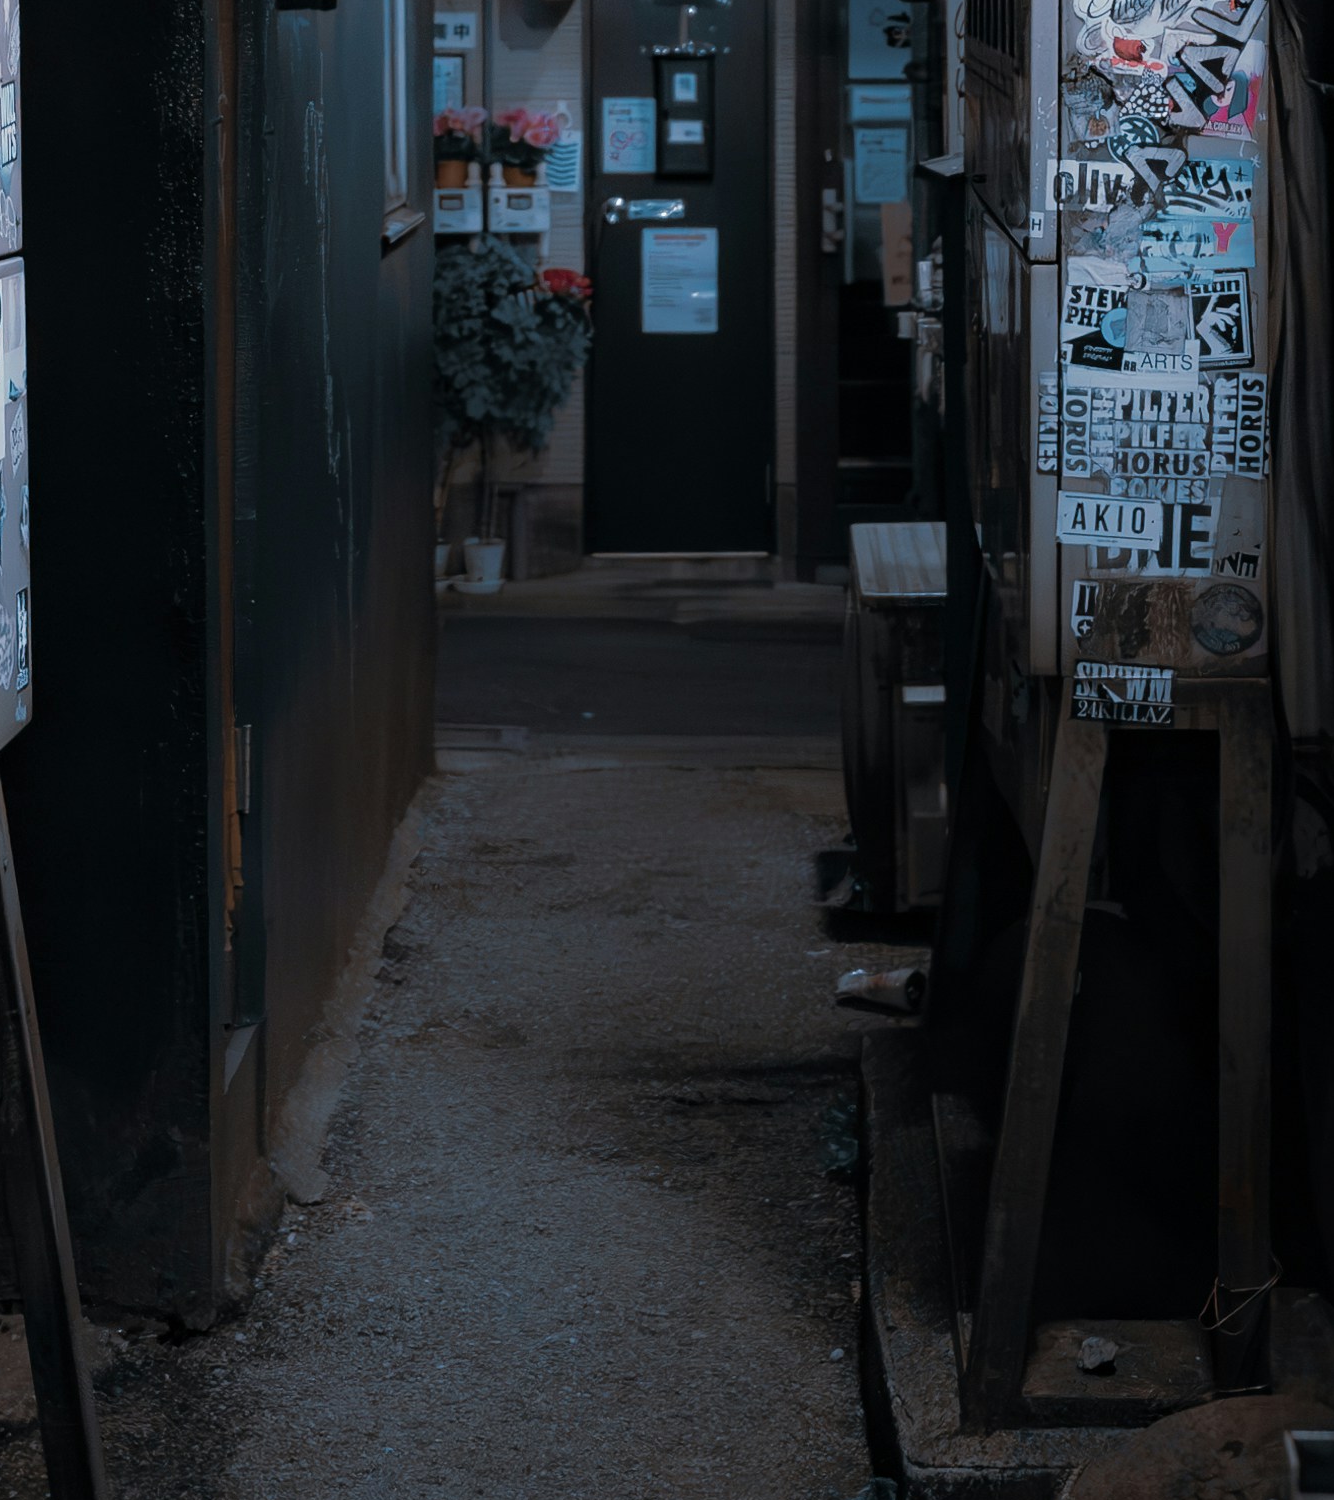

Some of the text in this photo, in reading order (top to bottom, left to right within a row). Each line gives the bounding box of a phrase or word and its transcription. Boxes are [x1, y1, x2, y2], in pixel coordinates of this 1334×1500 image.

[1031, 218, 1042, 231] H
[1212, 222, 1240, 254] Y
[1141, 353, 1193, 371] ARTS
[1114, 386, 1209, 423] PILFER
[1115, 422, 1207, 449] PILFER
[1239, 377, 1265, 473] HORUS
[1115, 451, 1207, 476] HORUS
[1071, 502, 1146, 535] AKIO
